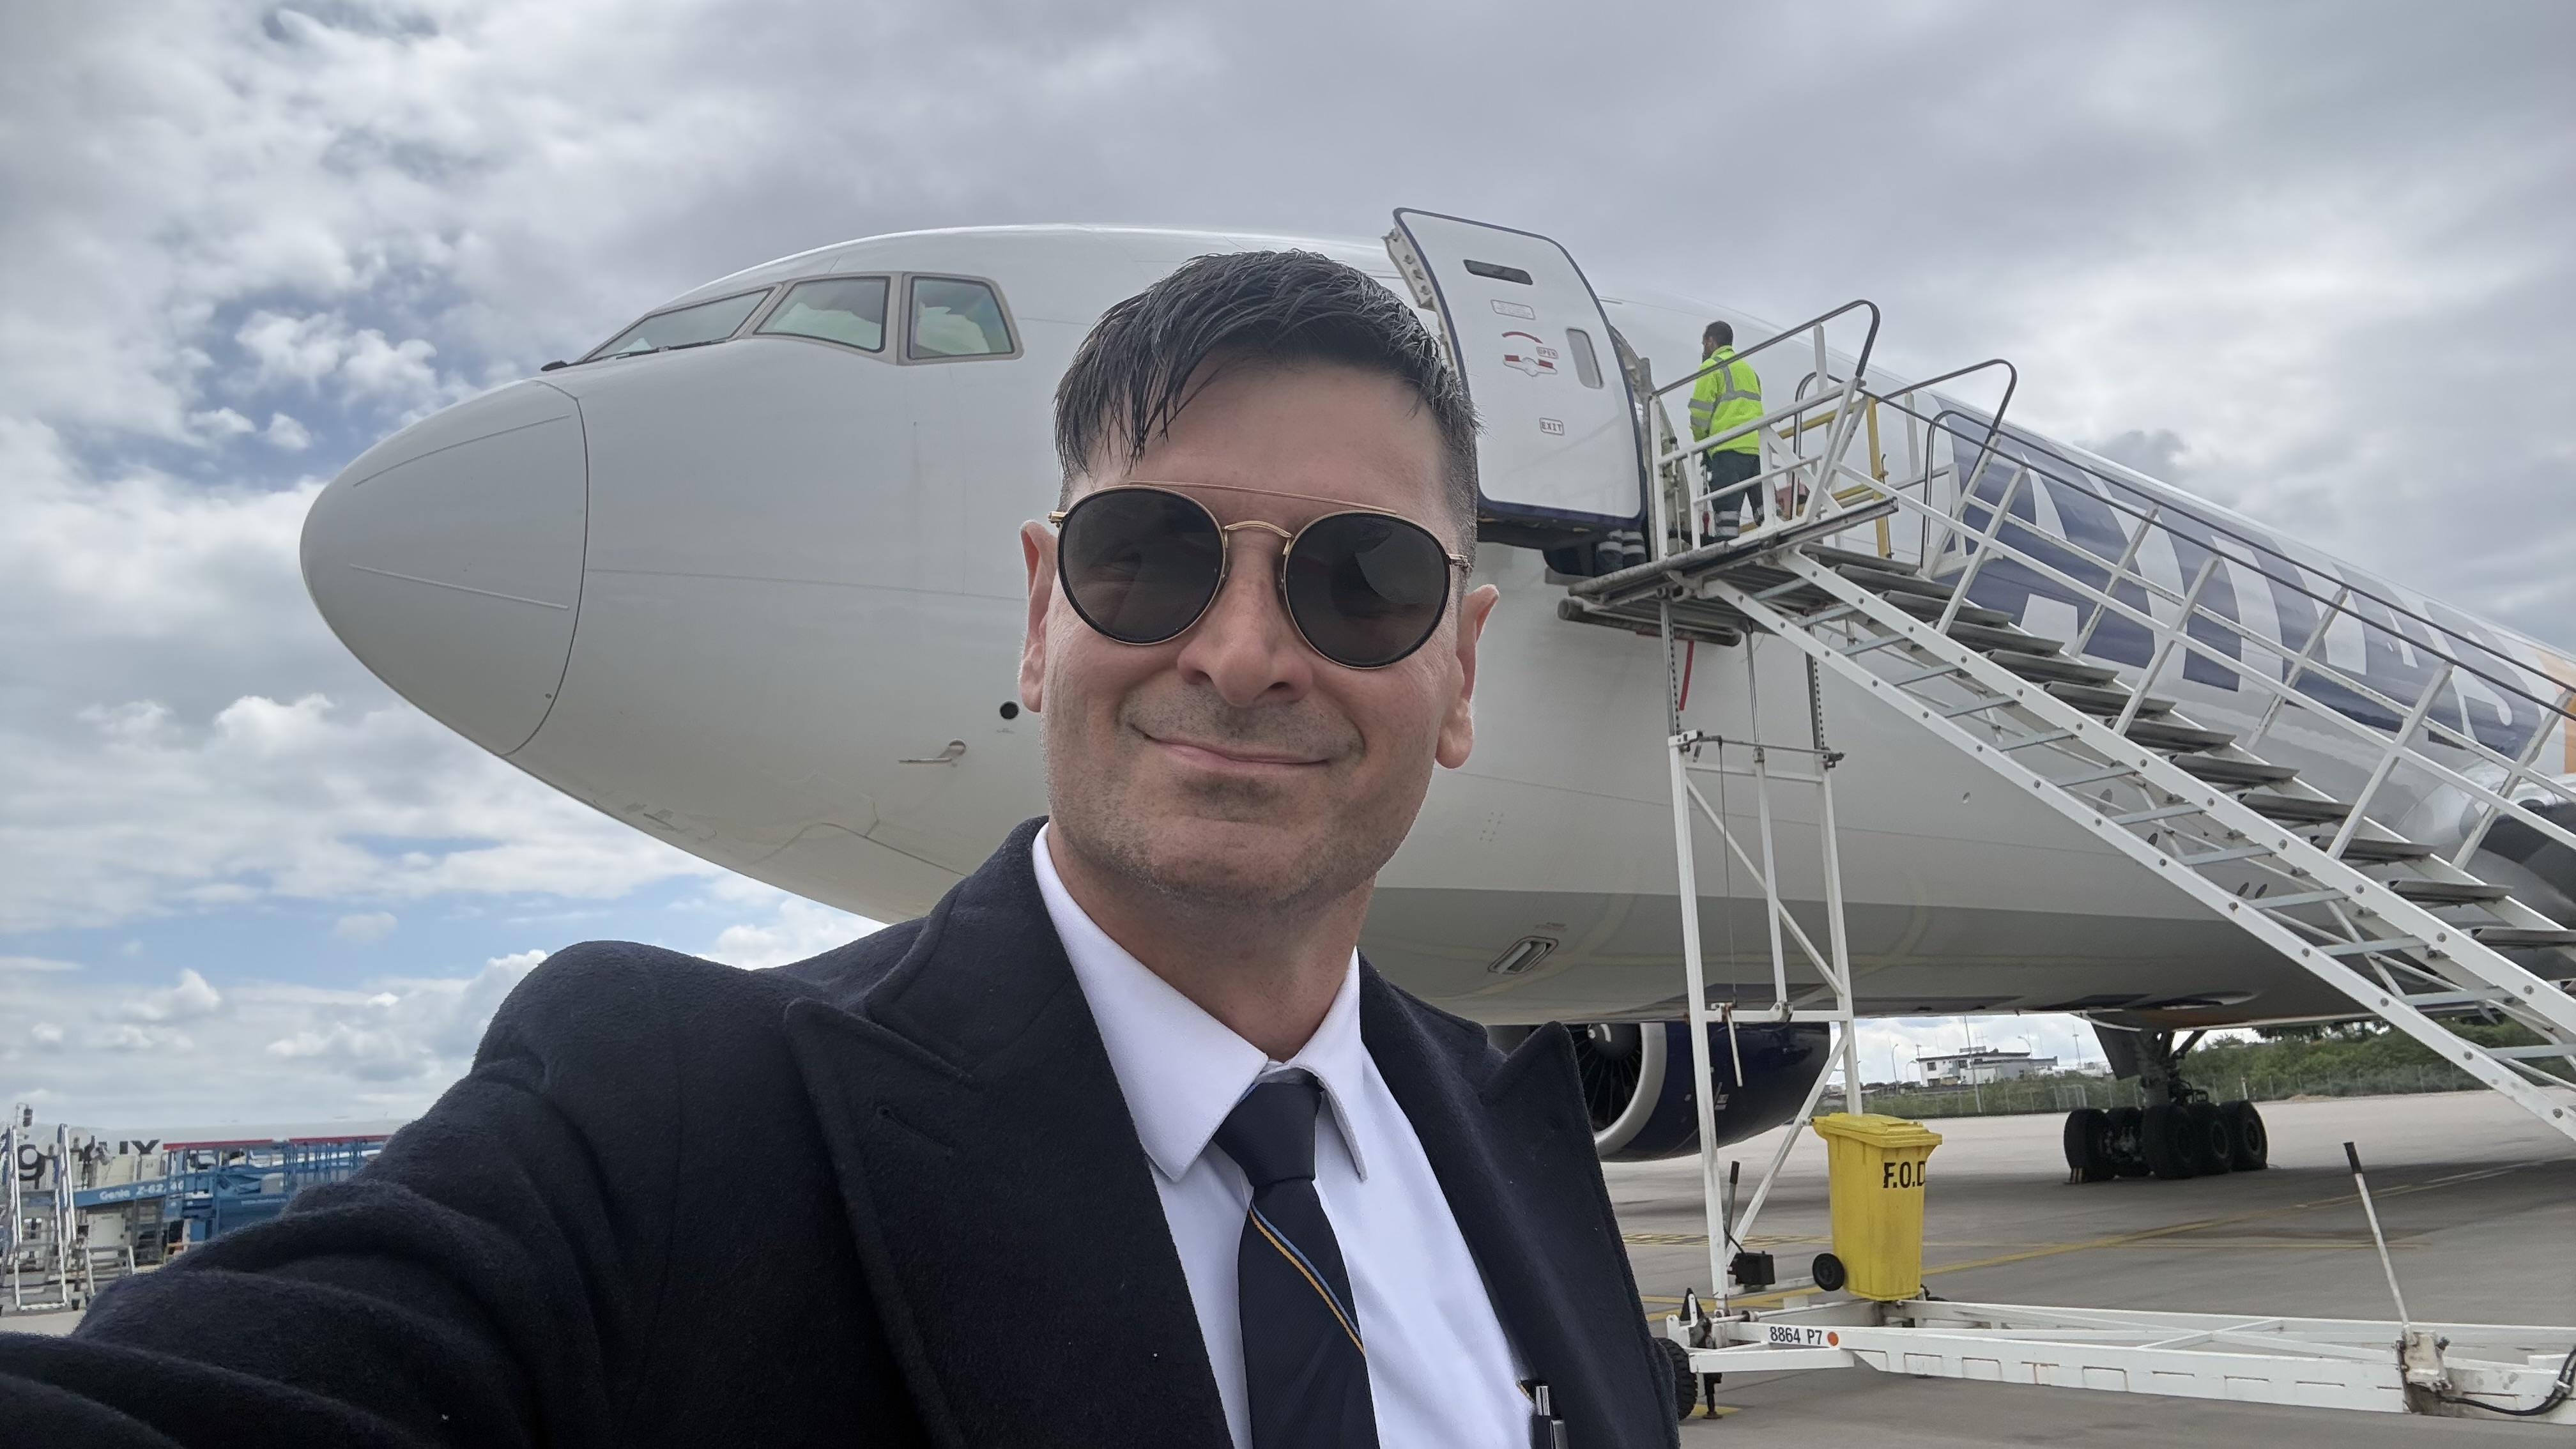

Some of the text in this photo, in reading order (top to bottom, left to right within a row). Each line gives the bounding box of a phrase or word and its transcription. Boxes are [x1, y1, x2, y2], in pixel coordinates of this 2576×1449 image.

[1542, 422, 1561, 432] EXIT
[1883, 1160, 1926, 1188] F.O.D
[1770, 1326, 1822, 1345] 8864 P7
